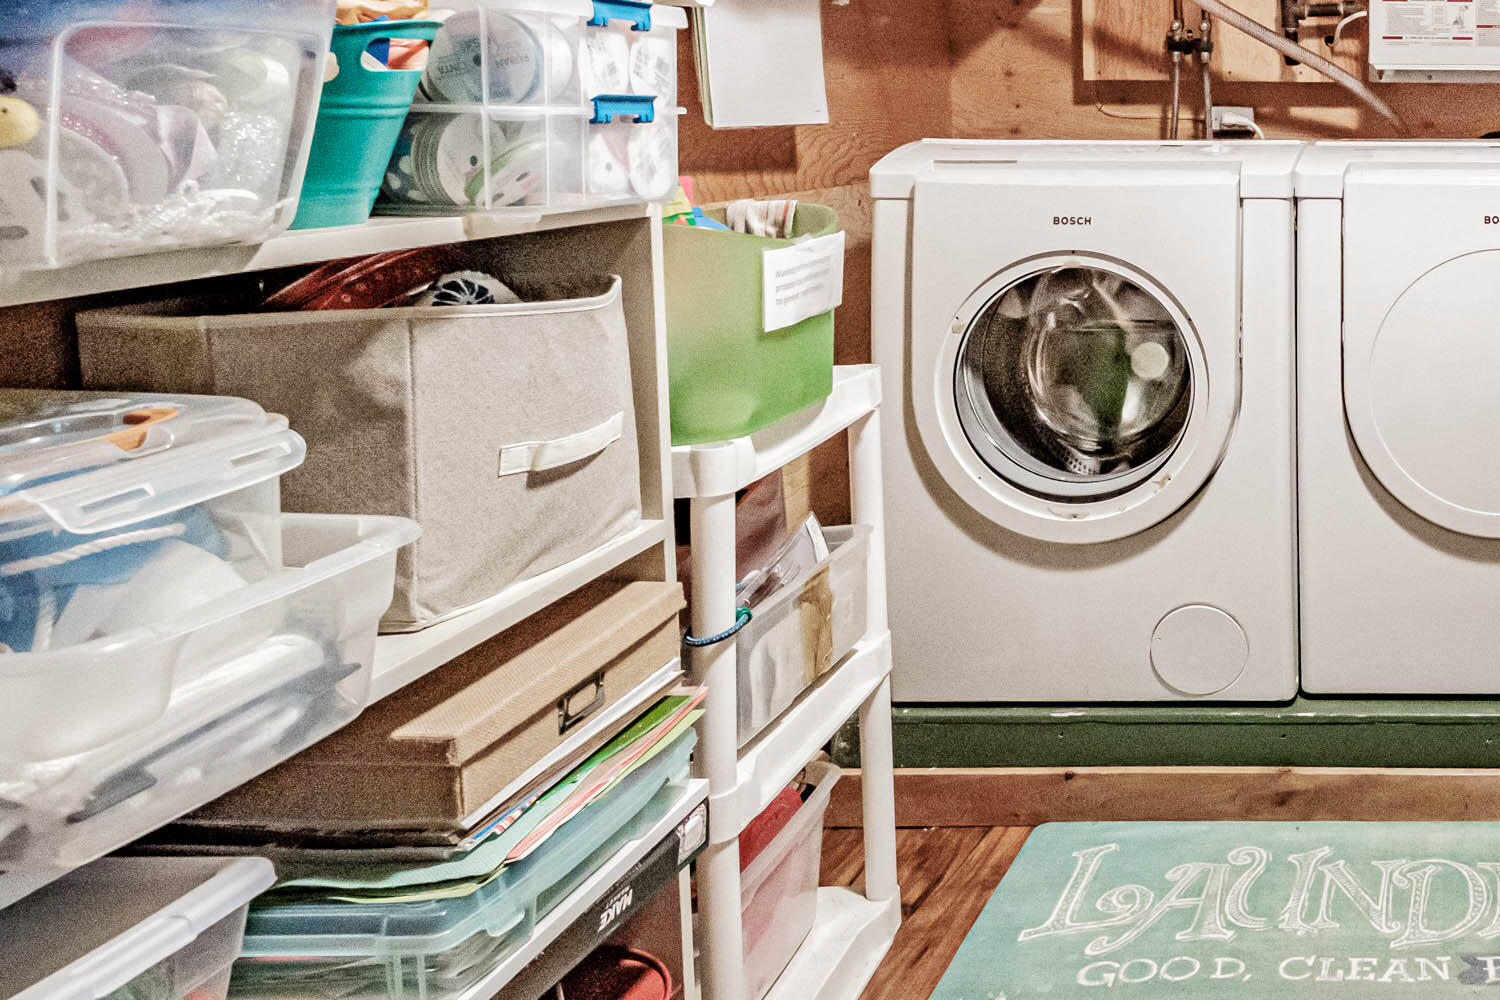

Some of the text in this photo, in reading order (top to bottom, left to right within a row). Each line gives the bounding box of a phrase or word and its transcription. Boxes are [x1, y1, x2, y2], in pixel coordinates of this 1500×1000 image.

[1053, 216, 1092, 226] BOSCH
[597, 888, 633, 933] MAKE
[1076, 956, 1253, 988] GOOD,
[1278, 955, 1453, 983] CLEAN
